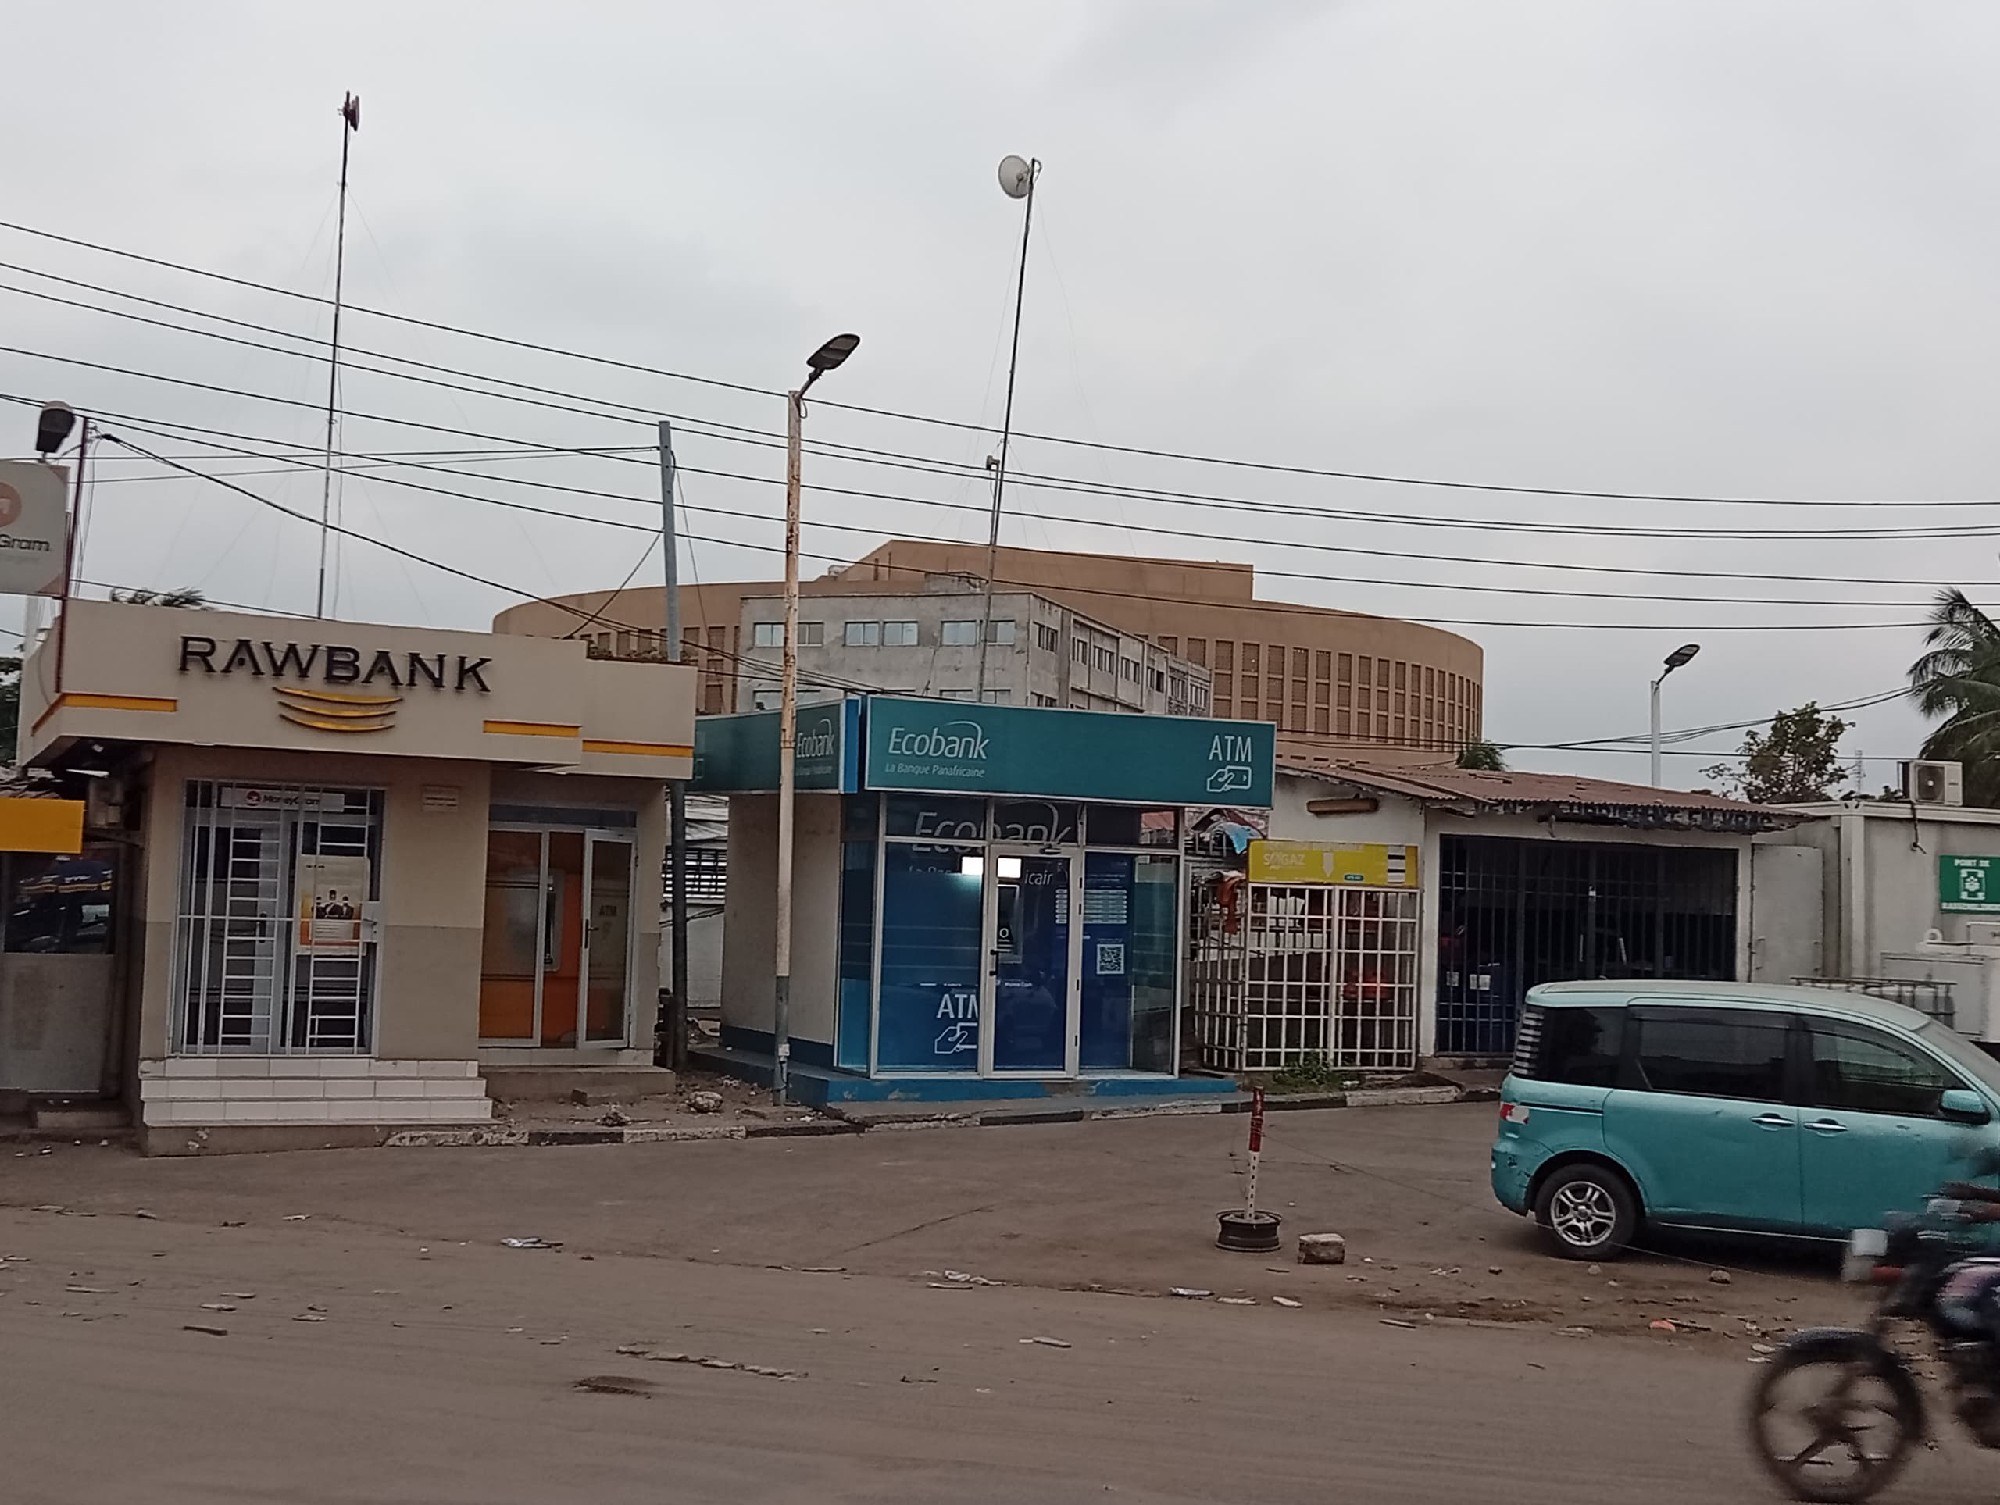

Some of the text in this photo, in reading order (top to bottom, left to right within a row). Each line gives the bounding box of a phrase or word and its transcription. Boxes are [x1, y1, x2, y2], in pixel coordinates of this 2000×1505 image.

[178, 635, 493, 692] RAWBANK
[796, 718, 835, 758] Ecobank
[888, 720, 990, 759] Ecobank
[1208, 734, 1253, 762] ATM
[885, 763, 985, 778] La Banque Panafricaine
